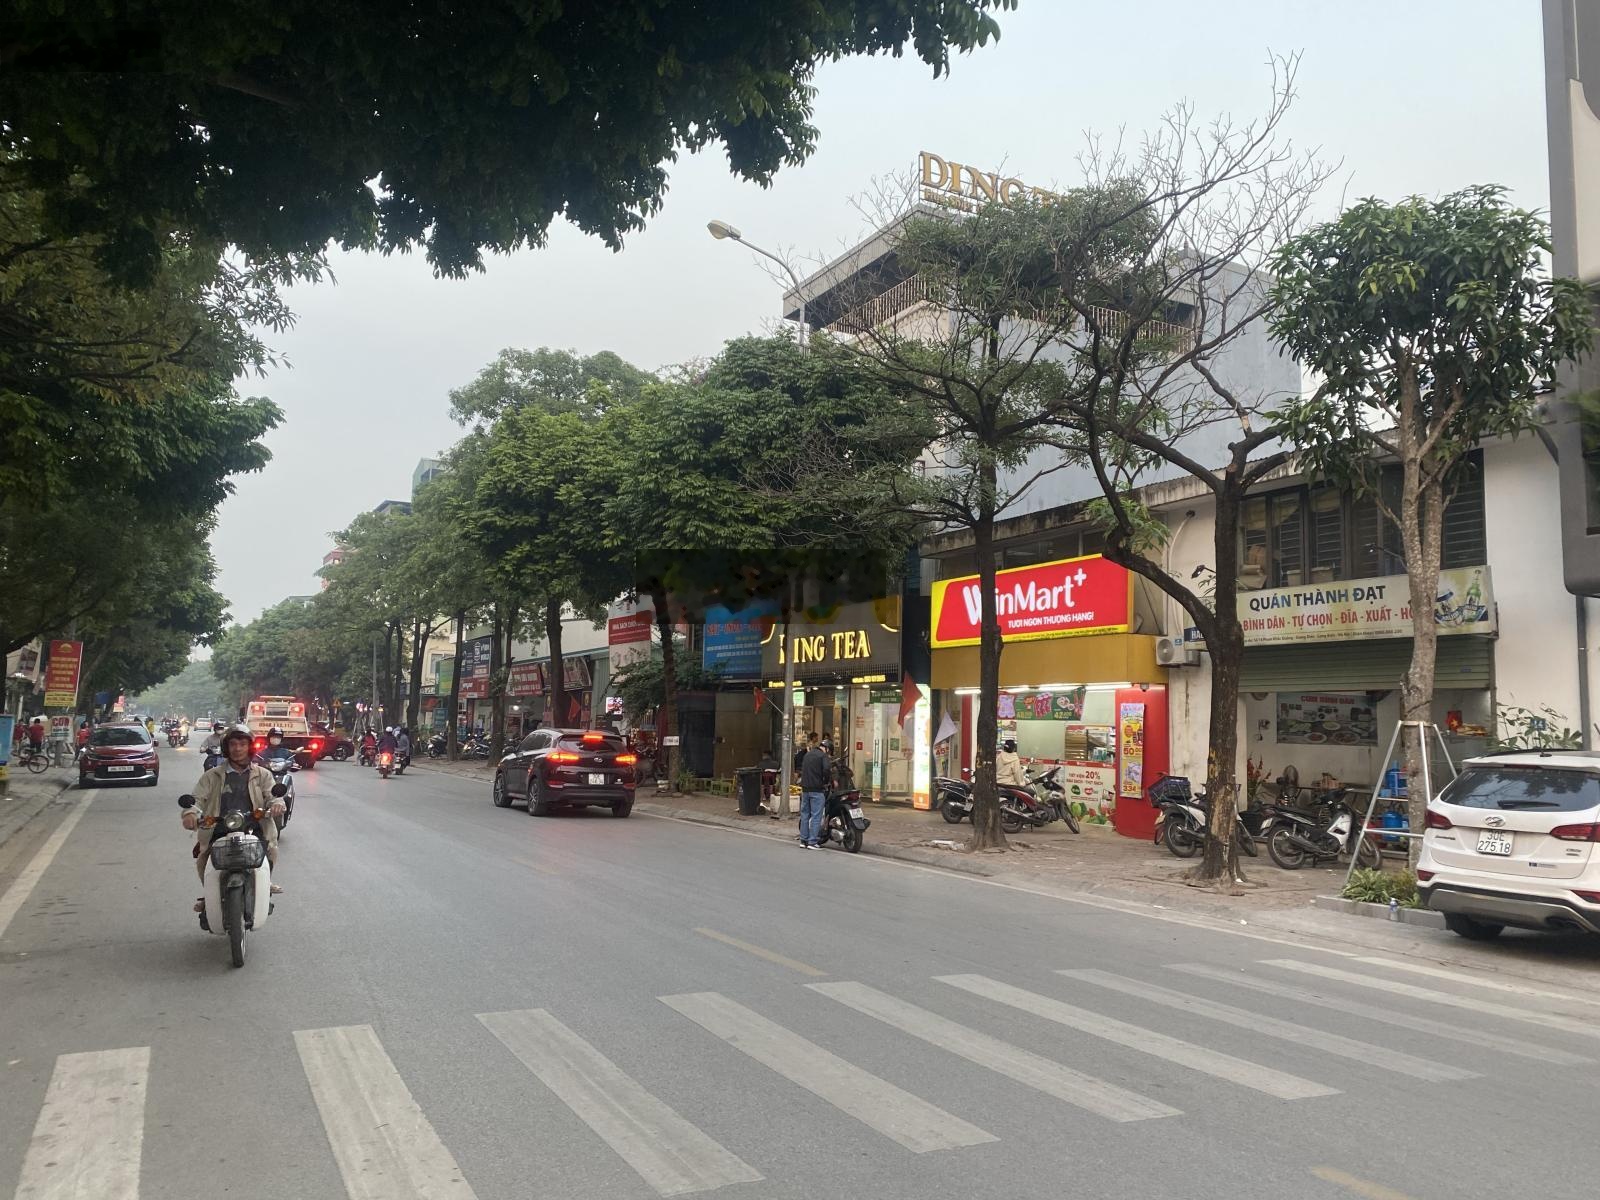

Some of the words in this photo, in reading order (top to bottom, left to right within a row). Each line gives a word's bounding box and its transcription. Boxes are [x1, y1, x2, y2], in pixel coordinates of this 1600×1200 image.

[1249, 593, 1292, 612] QUÁN
[1293, 588, 1349, 607] THÀNH
[1352, 585, 1386, 605] ĐẠT
[1023, 617, 1043, 628] NGON
[1243, 617, 1265, 631] BÌNH
[1267, 615, 1285, 629] DÂN
[1306, 612, 1333, 629] CHỌN
[1365, 605, 1392, 622] XUẤT
[831, 630, 871, 660] TEA
[1477, 841, 1511, 854] 275.18
